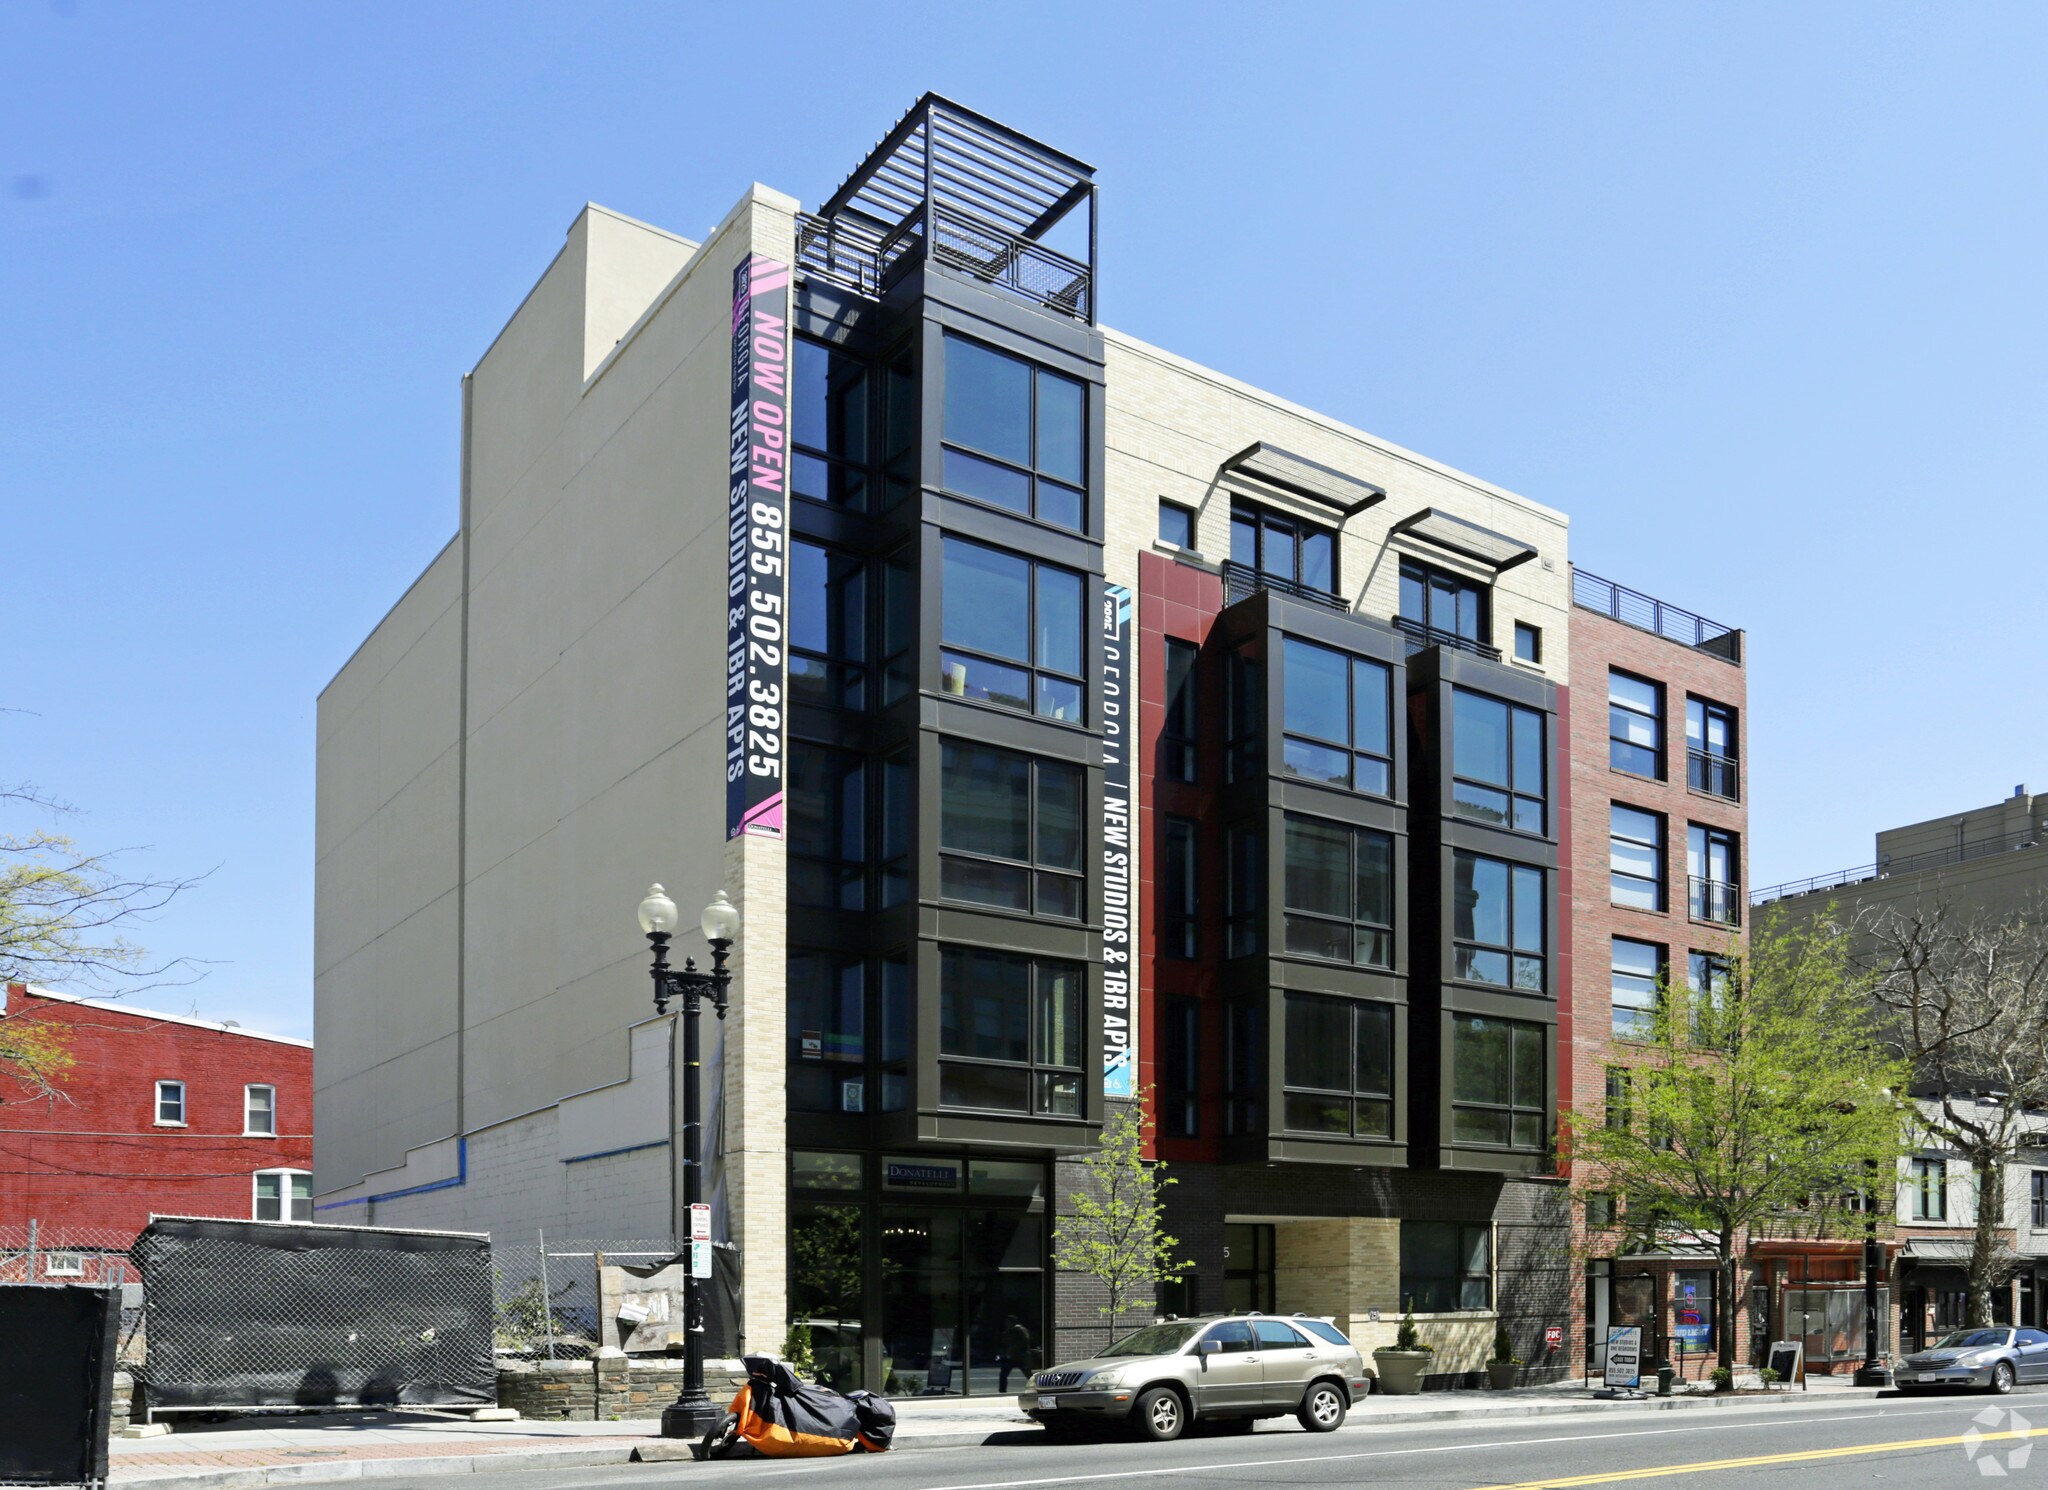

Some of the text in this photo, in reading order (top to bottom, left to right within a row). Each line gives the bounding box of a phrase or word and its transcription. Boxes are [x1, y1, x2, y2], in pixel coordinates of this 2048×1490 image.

[738, 300, 749, 387] GEORGIA
[749, 310, 784, 778] NOW OPEN 855.502.3825
[727, 399, 748, 783] NEW STUDIO & 1BR APTS
[1103, 796, 1128, 1068] NEW STUDIOS & 1BR APTS
[890, 1165, 949, 1179] DONATELLI
[1547, 1330, 1561, 1339] FDC
[1687, 1328, 1709, 1337] LIGHT
